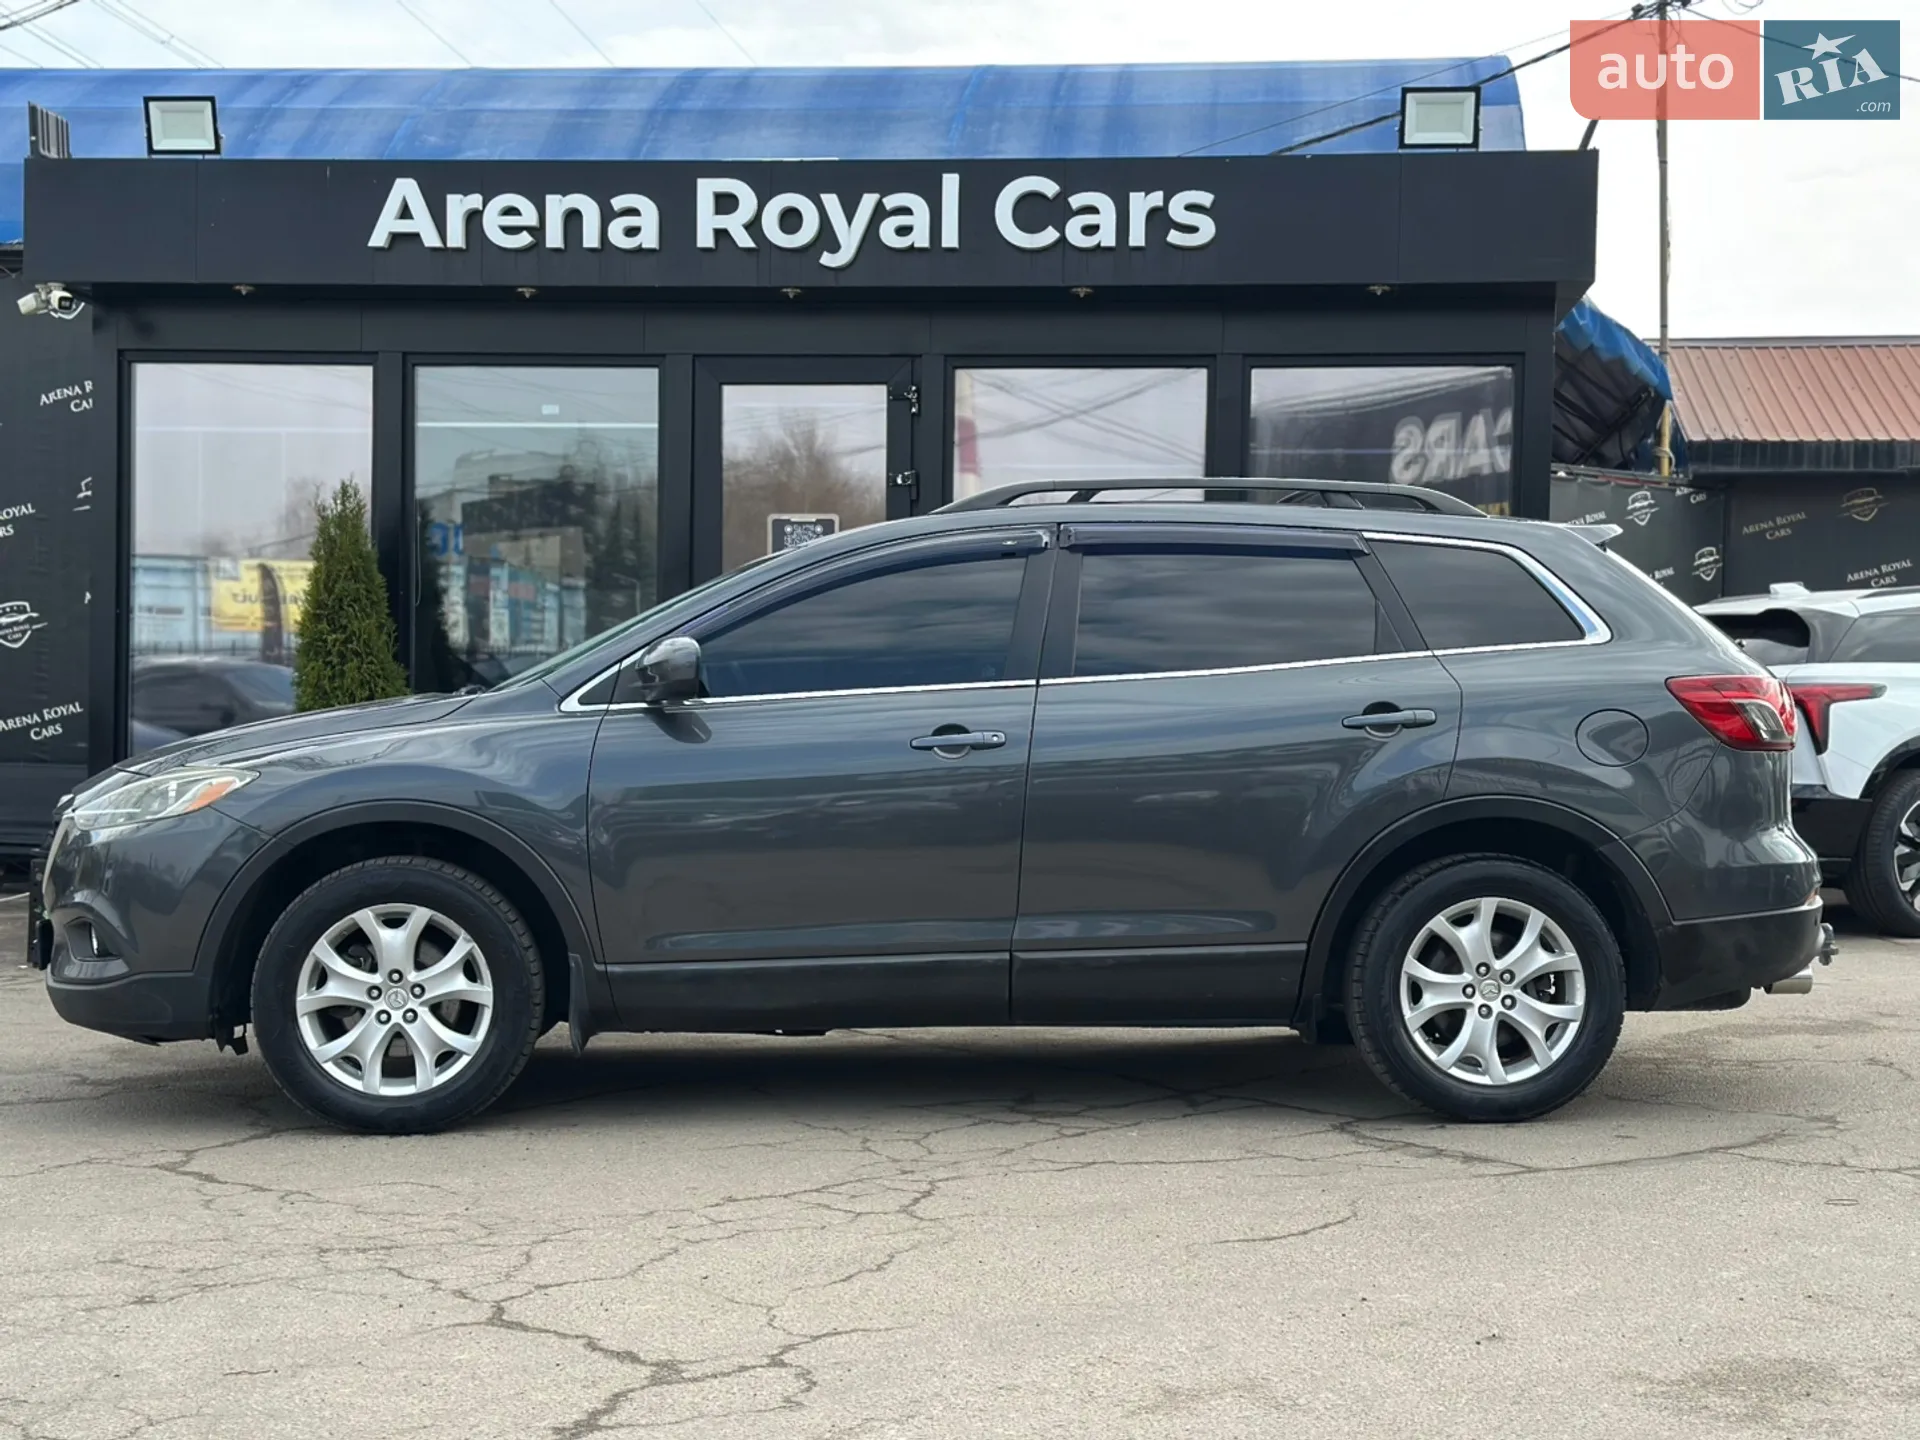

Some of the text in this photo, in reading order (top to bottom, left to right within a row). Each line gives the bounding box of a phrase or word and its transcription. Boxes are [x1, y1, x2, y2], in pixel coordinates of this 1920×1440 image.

[367, 173, 1217, 268] Arena Royal Cars
[40, 385, 82, 406] ARENA
[1742, 511, 1807, 535] ARENA ROYAL
[1766, 527, 1792, 540] CARS
[1846, 558, 1913, 583] ARENA ROYAL
[1870, 575, 1898, 588] CARS
[0, 701, 84, 731] ARENA ROYAL
[30, 722, 63, 741] CARS
